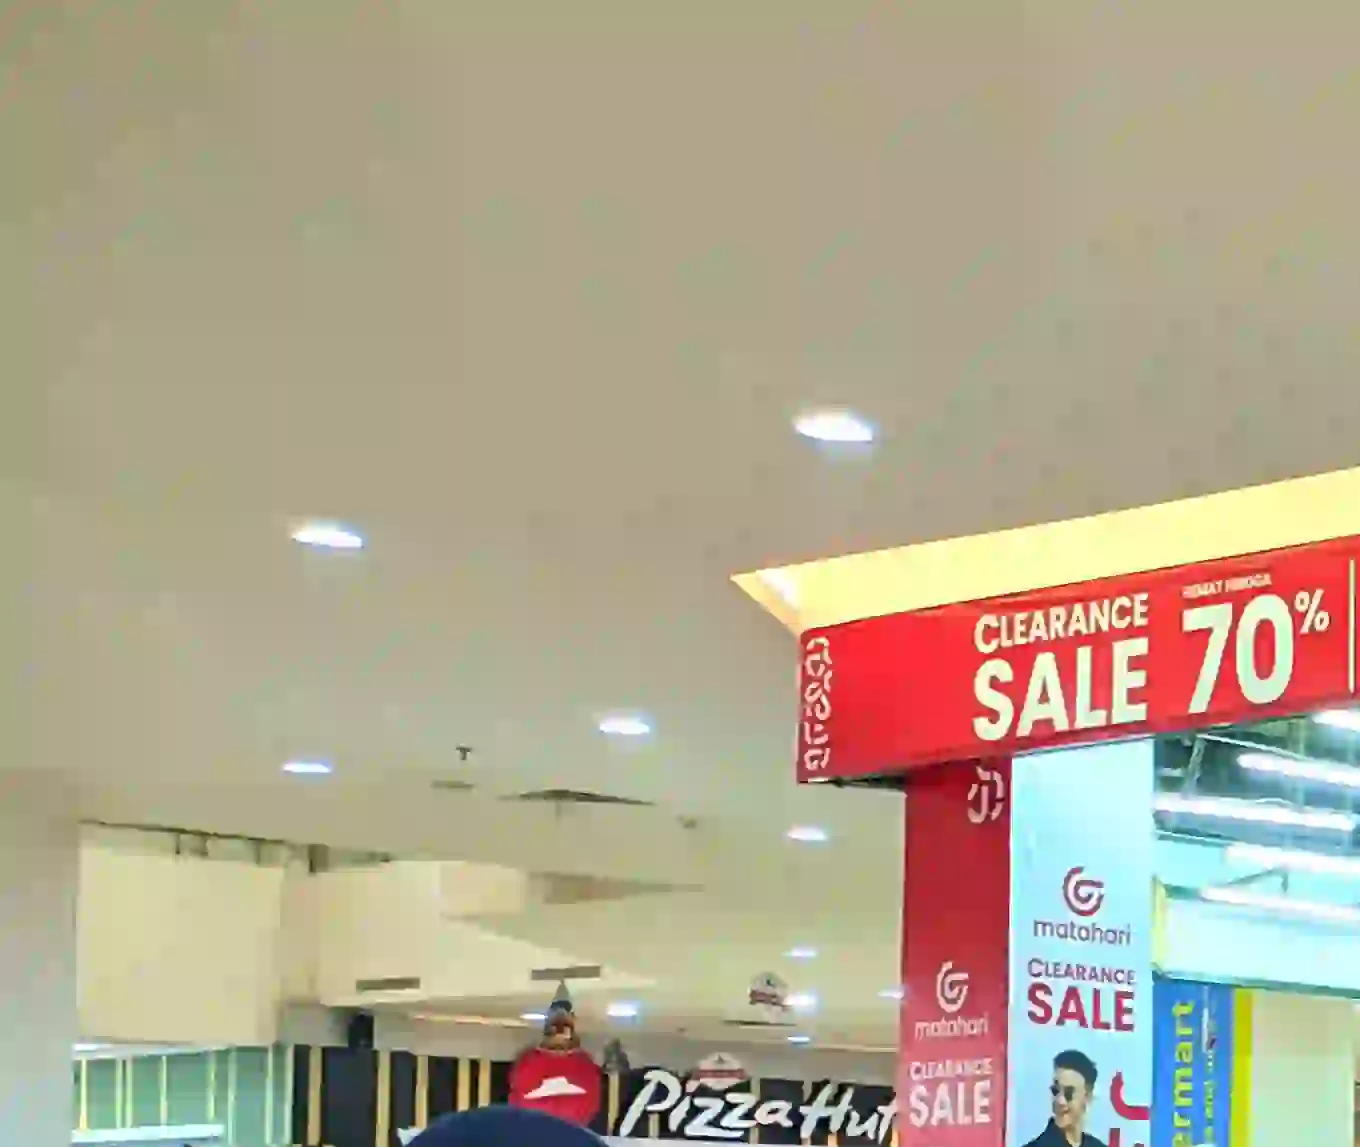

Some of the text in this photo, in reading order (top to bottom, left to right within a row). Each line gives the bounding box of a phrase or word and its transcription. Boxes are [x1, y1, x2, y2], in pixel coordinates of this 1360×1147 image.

[972, 592, 1150, 654] CLEARANCE
[1182, 588, 1331, 715] 70%
[972, 636, 1150, 742] SALE
[1032, 919, 1132, 947] matahari
[1027, 957, 1137, 985] CLEARANCE
[914, 1011, 990, 1041] matahari
[1027, 981, 1135, 1033] SALE
[909, 1057, 995, 1081] CLEARANCE
[619, 1069, 898, 1145] Pizza Hut
[909, 1079, 993, 1128] SALE
